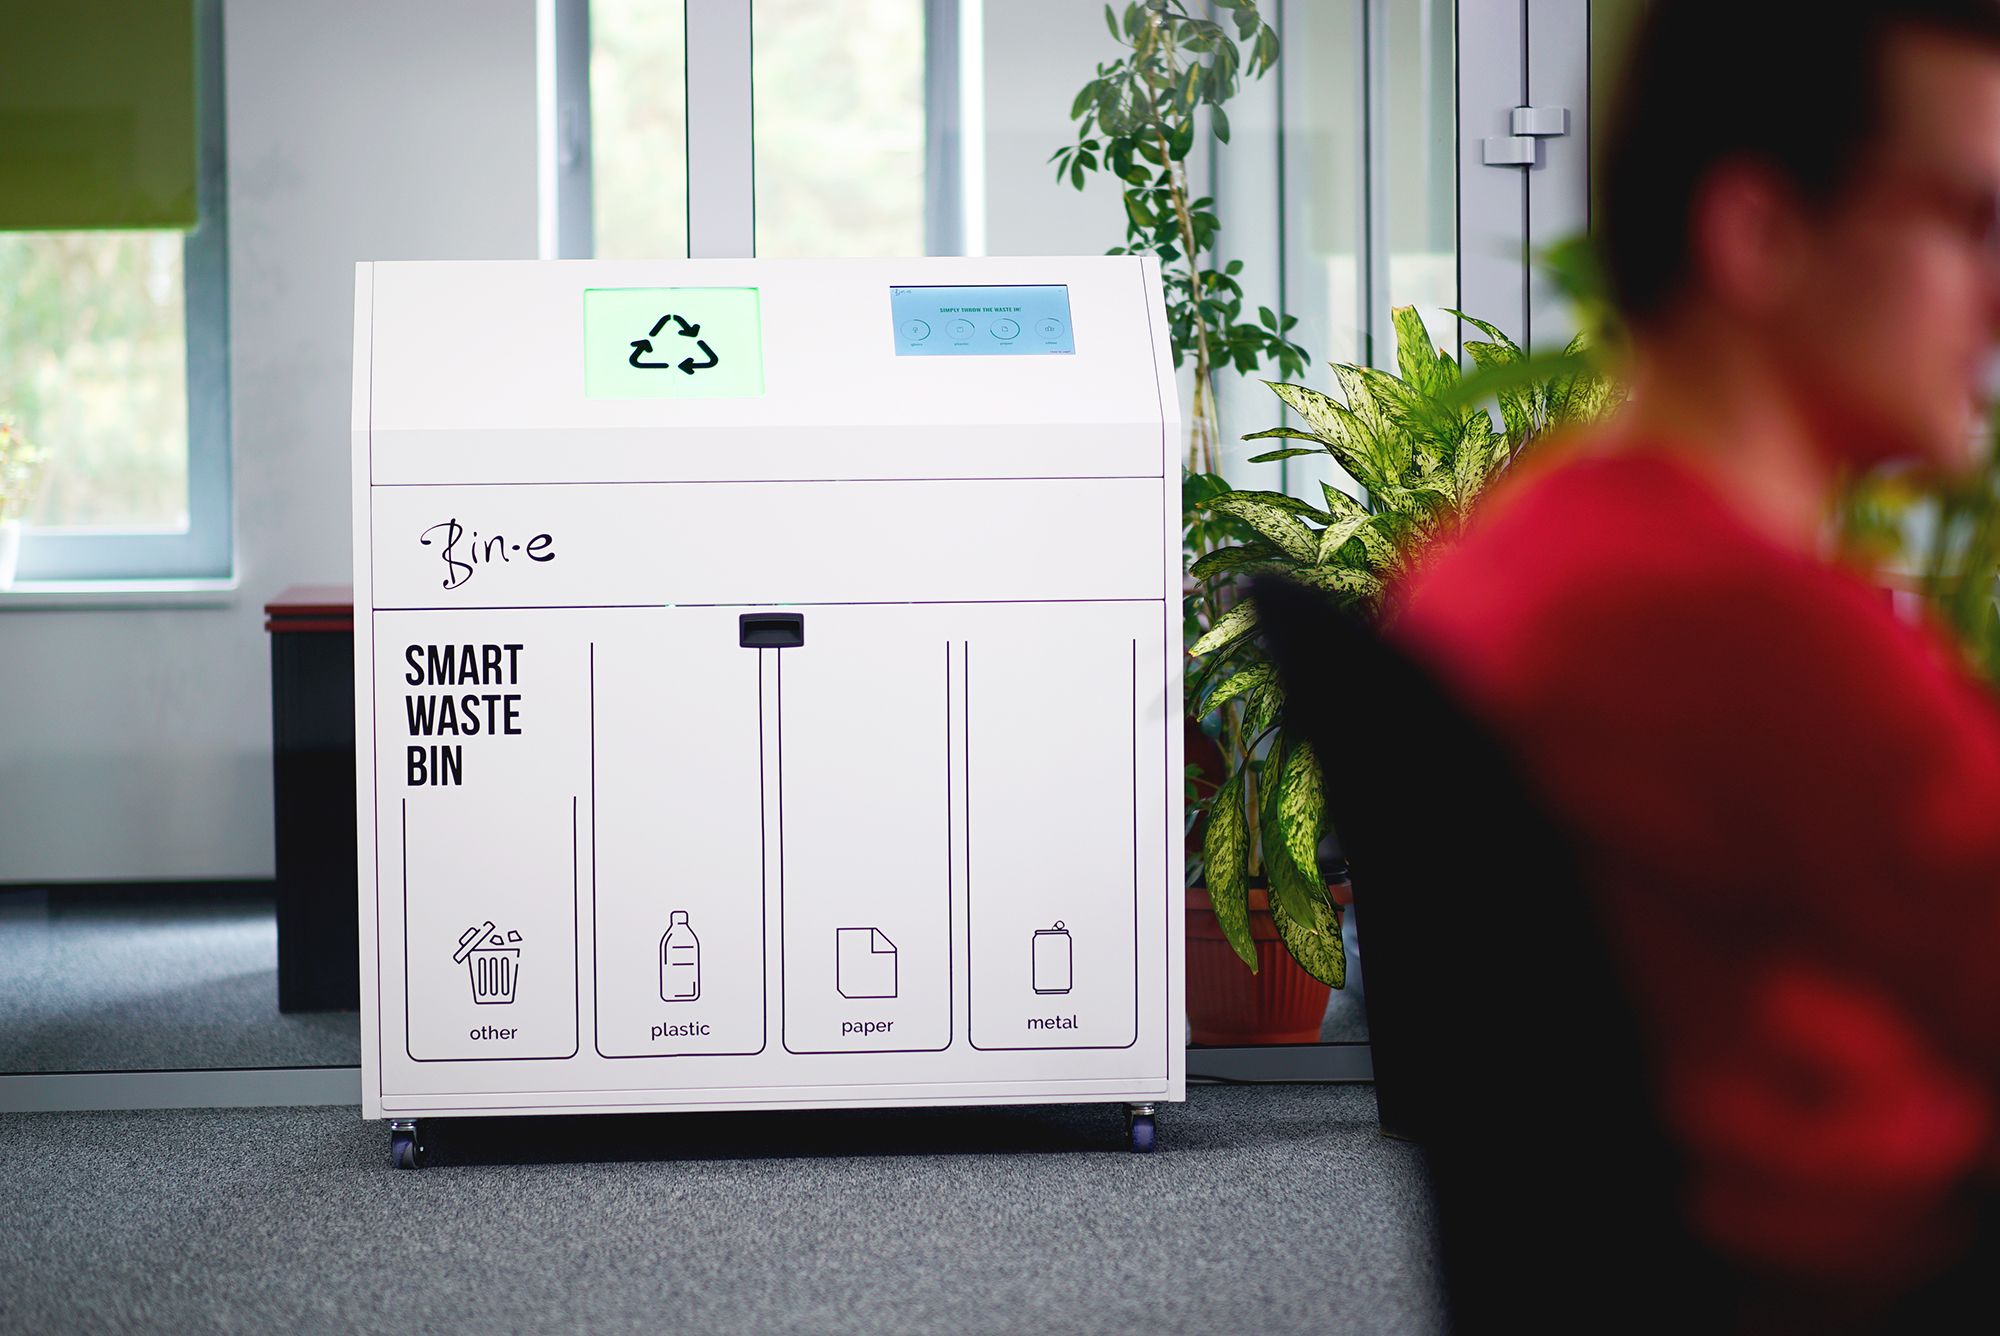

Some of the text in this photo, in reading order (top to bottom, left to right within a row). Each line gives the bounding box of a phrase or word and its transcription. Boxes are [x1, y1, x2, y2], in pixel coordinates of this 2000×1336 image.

[405, 643, 524, 687] SMART
[405, 694, 522, 737] WASTE
[406, 744, 463, 787] BIN
[651, 1020, 711, 1041] plastic
[842, 1021, 894, 1037] paper
[1027, 1014, 1079, 1030] metal
[469, 1025, 518, 1041] other
